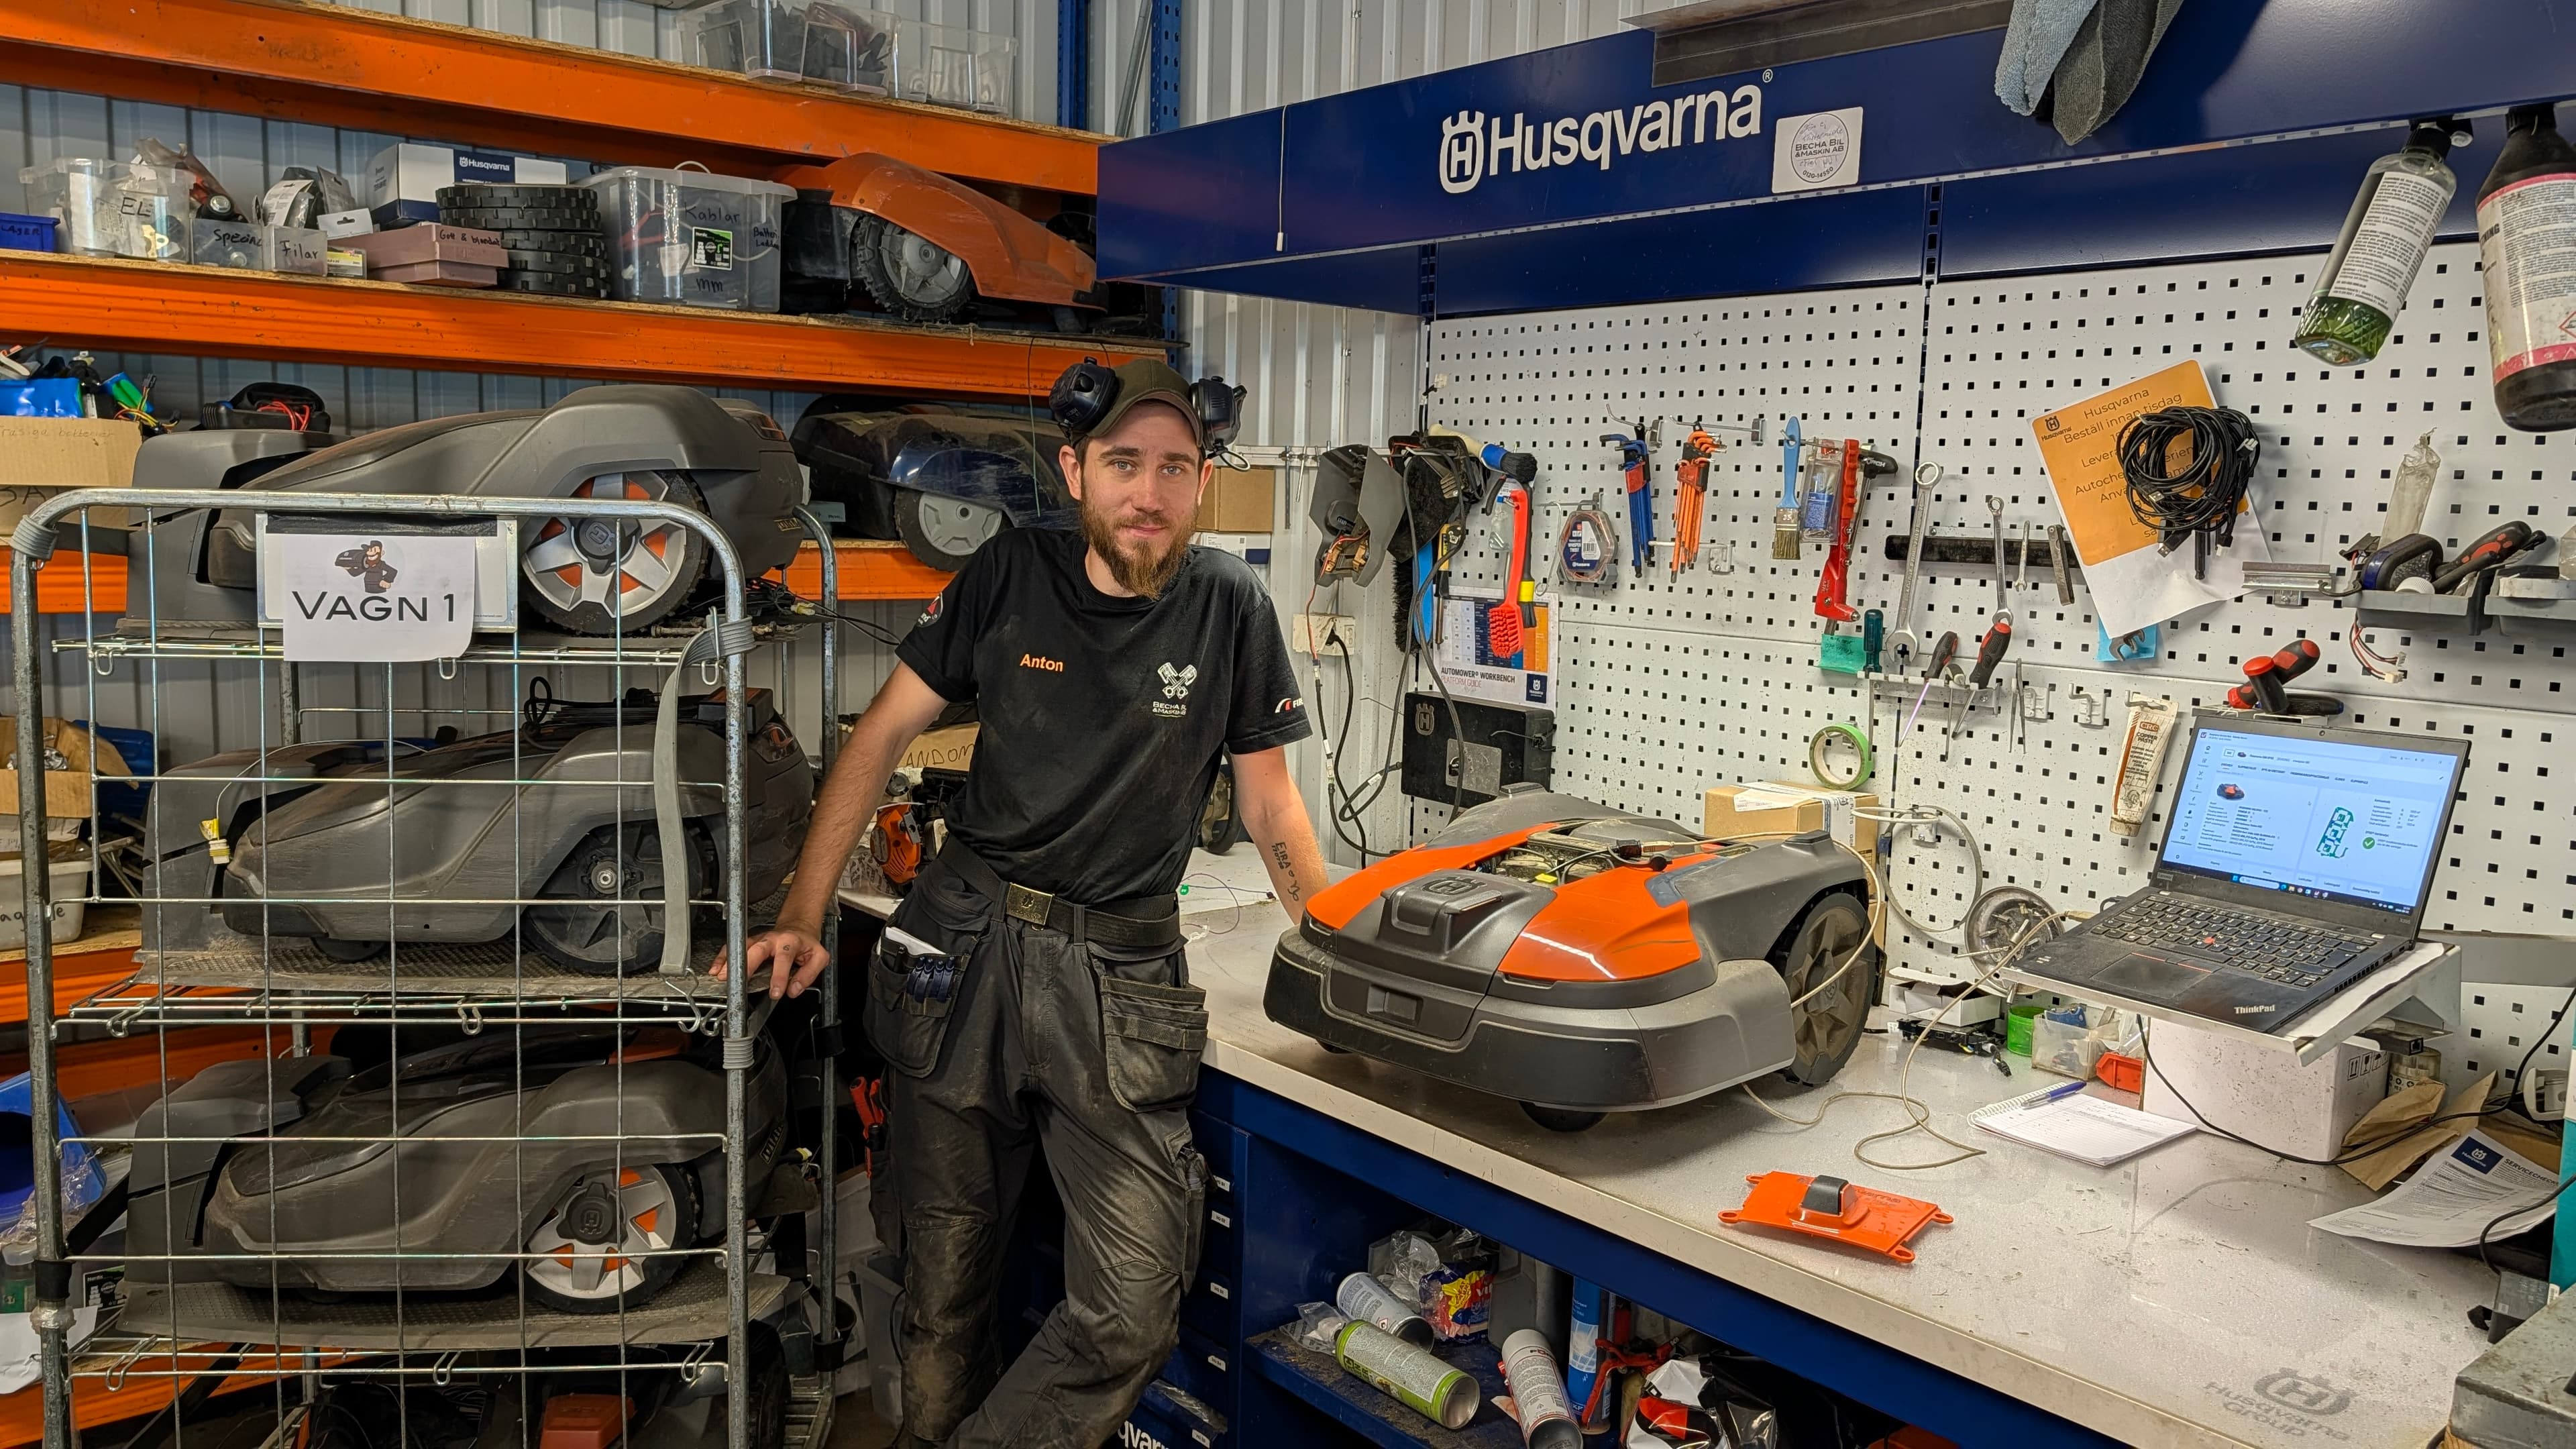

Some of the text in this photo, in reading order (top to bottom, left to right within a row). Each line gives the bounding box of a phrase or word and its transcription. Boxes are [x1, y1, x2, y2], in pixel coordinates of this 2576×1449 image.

[1794, 148, 1830, 158] &MASKIN
[1795, 142, 1827, 152] BECHA
[468, 159, 510, 171] Husqvarna
[1803, 166, 1833, 178] 0120-14550
[461, 233, 468, 242] &
[2083, 387, 2149, 419] Husqvarna
[2063, 421, 2104, 443] Beställ
[2106, 411, 2141, 428] innan
[2143, 393, 2183, 416] tisdag
[2041, 425, 2072, 441] Husqvarna
[2081, 449, 2118, 468] Levera
[292, 590, 454, 623] VAGN 1
[1019, 653, 1064, 672] Anton
[1480, 672, 1515, 684] WORKBENCH
[2141, 722, 2159, 732] CRC
[2136, 732, 2158, 741] COPPER
[2137, 737, 2154, 745] PASTE
[1275, 841, 1291, 869] EIRA
[2233, 1004, 2275, 1014] ThinkPad
